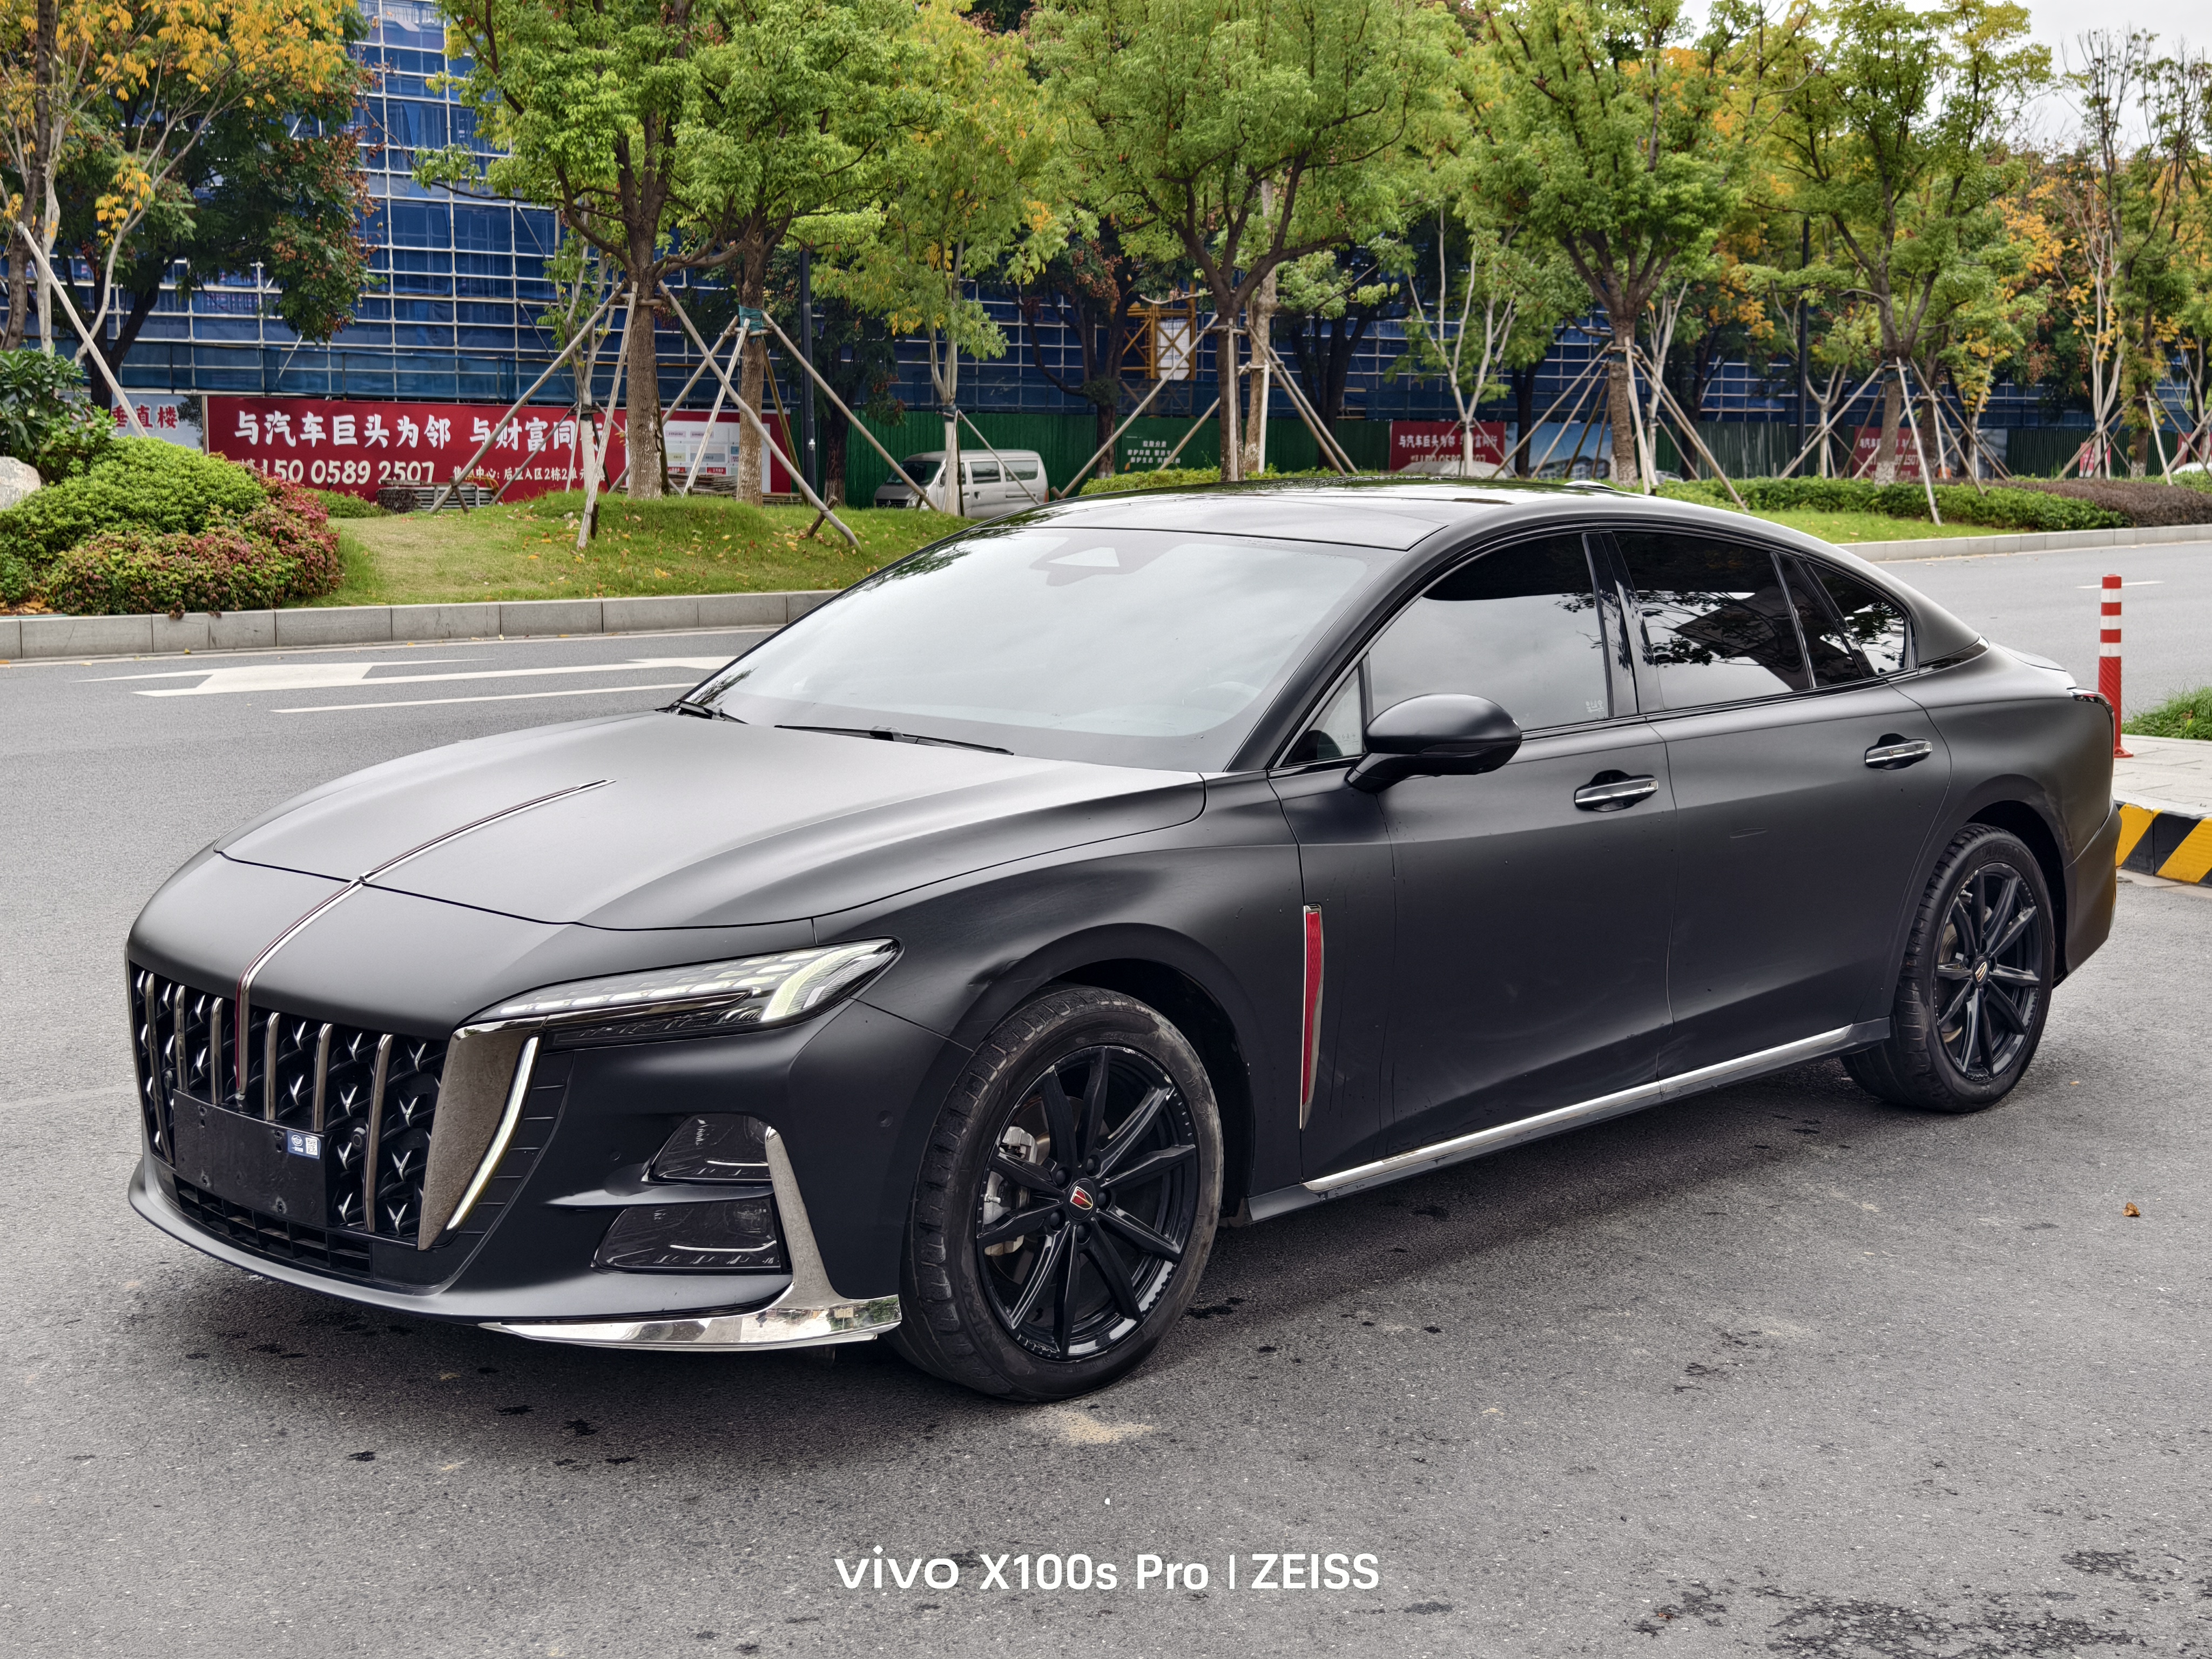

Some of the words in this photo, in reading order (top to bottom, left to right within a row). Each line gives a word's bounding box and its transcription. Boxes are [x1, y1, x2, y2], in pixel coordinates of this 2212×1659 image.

[234, 410, 451, 449] 与汽车巨头为邻
[469, 416, 604, 452] 与财富同
[311, 459, 371, 484] 0589
[378, 460, 435, 485] 2507
